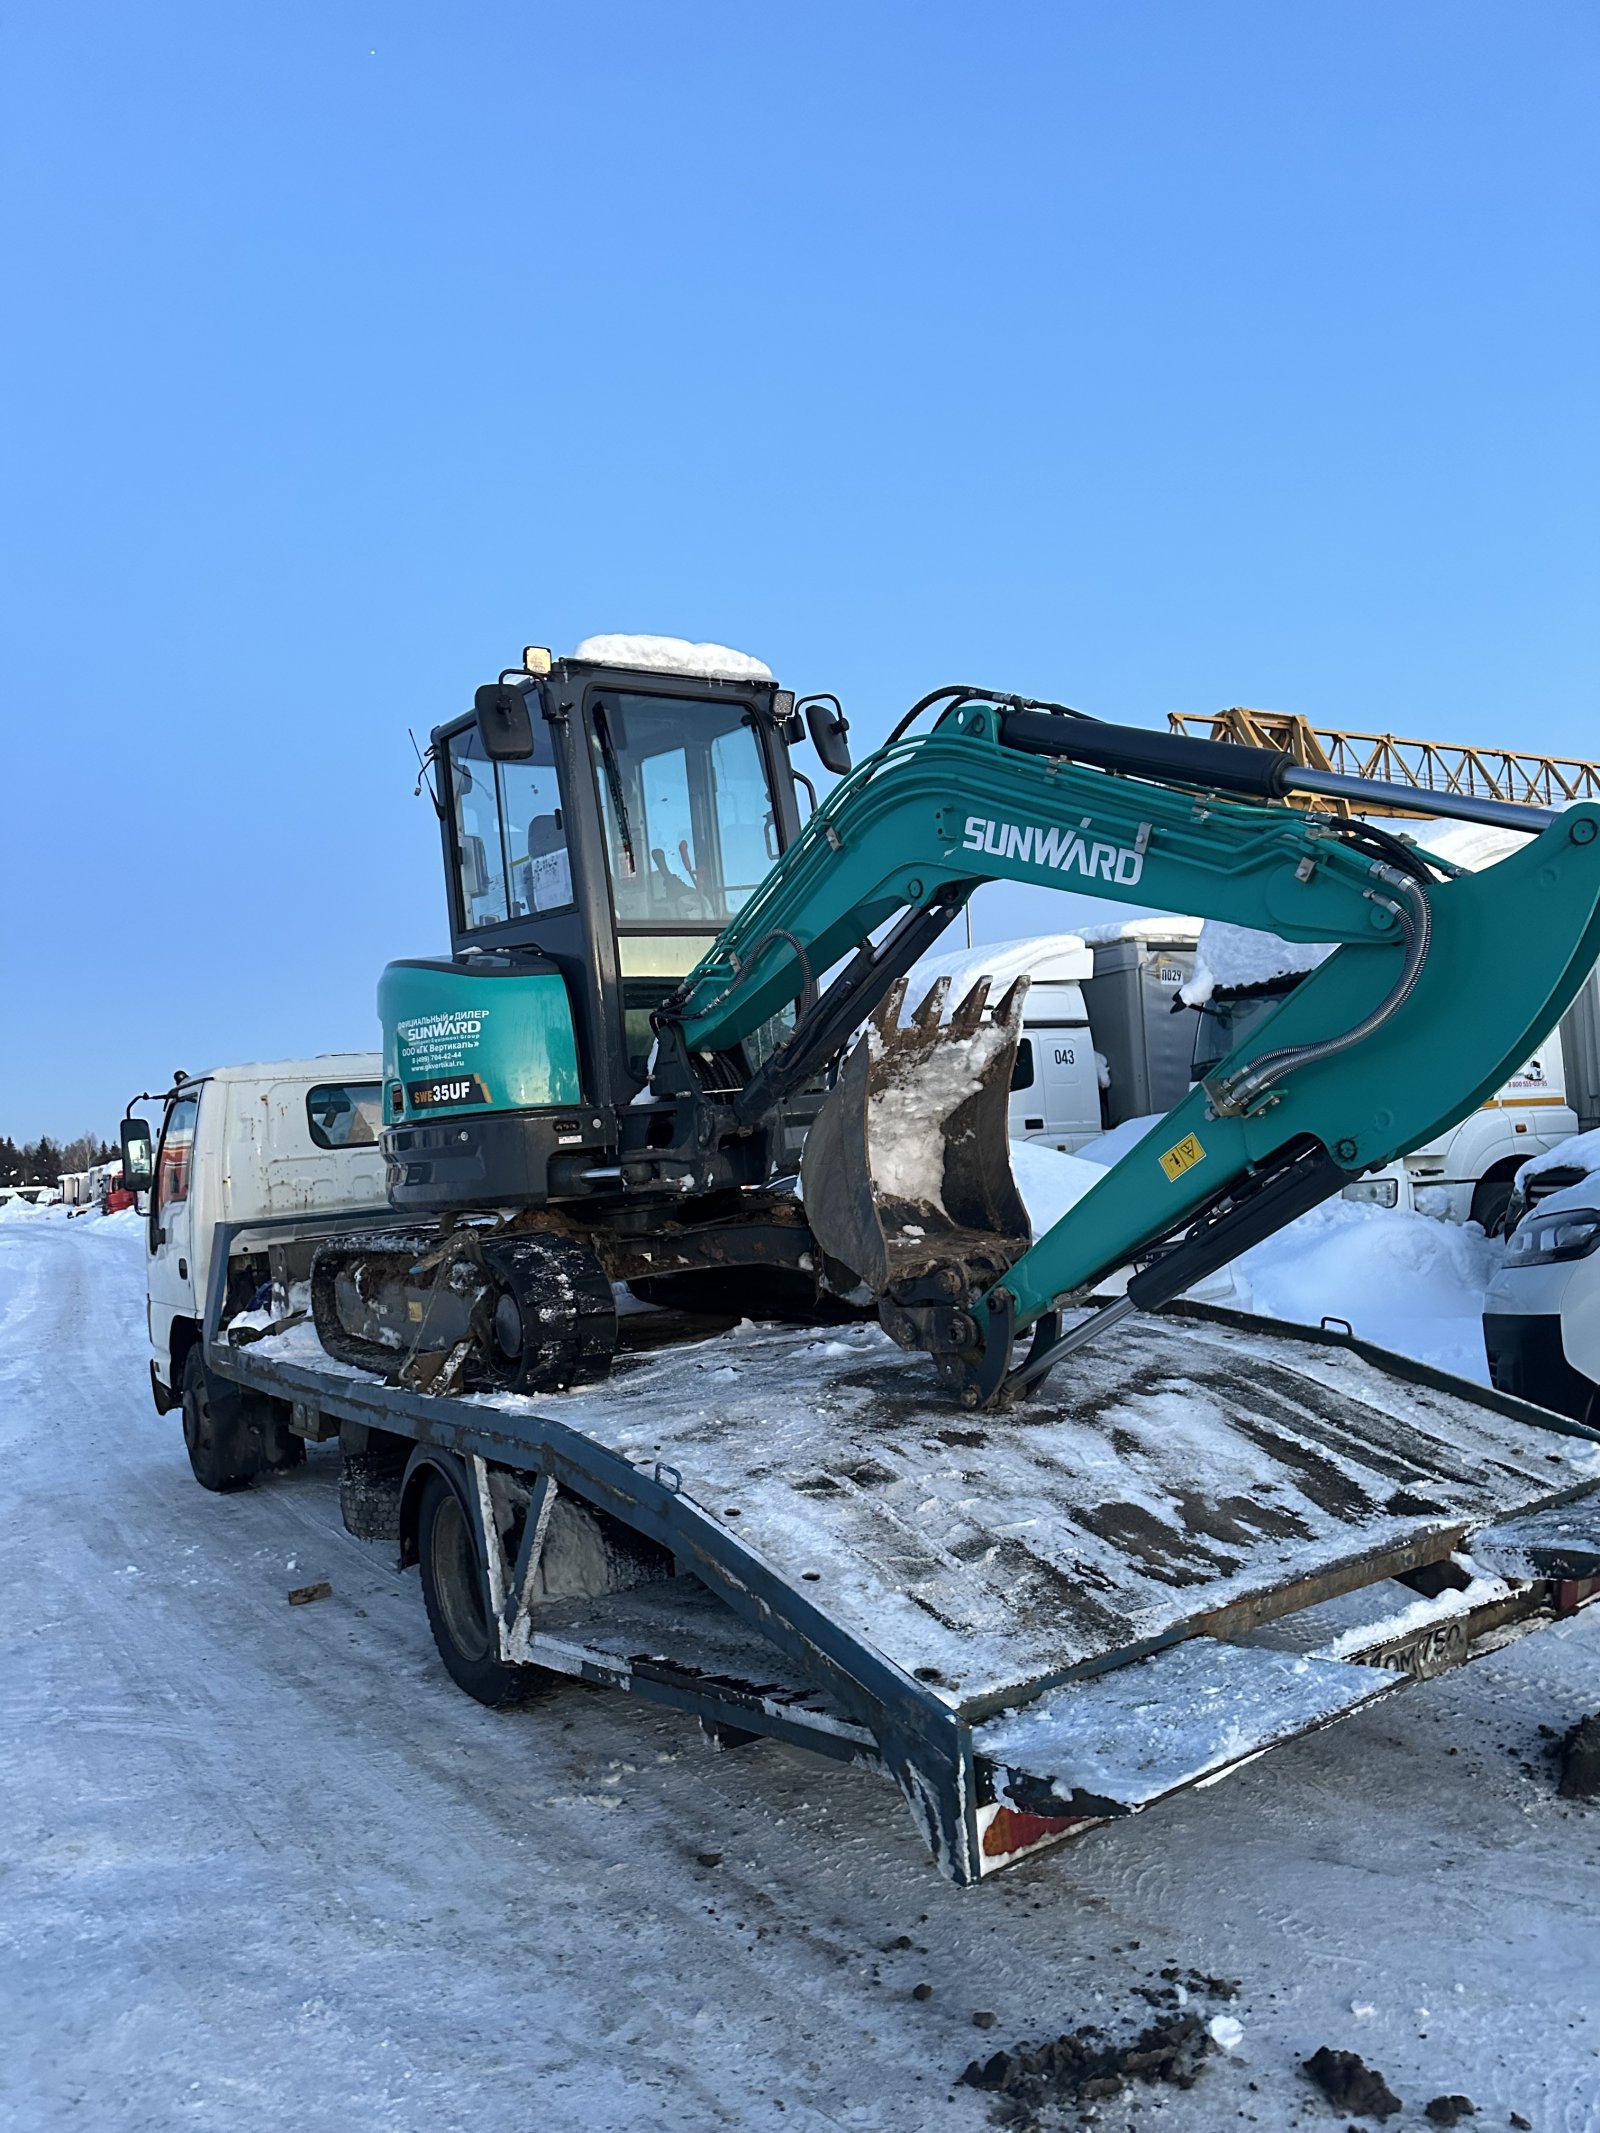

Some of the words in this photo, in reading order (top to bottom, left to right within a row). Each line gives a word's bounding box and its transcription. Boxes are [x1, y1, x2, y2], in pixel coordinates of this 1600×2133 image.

[962, 816, 1144, 886] SUNWARD
[397, 1012, 449, 1030] ОФИЦИАЛЬНЫЙ
[454, 1010, 490, 1022] ДИЛЕР
[408, 1016, 481, 1041] SUNWARD
[402, 1047, 416, 1056] ООО
[429, 1041, 479, 1053] Вертикаль»
[1054, 1049, 1075, 1065] 043
